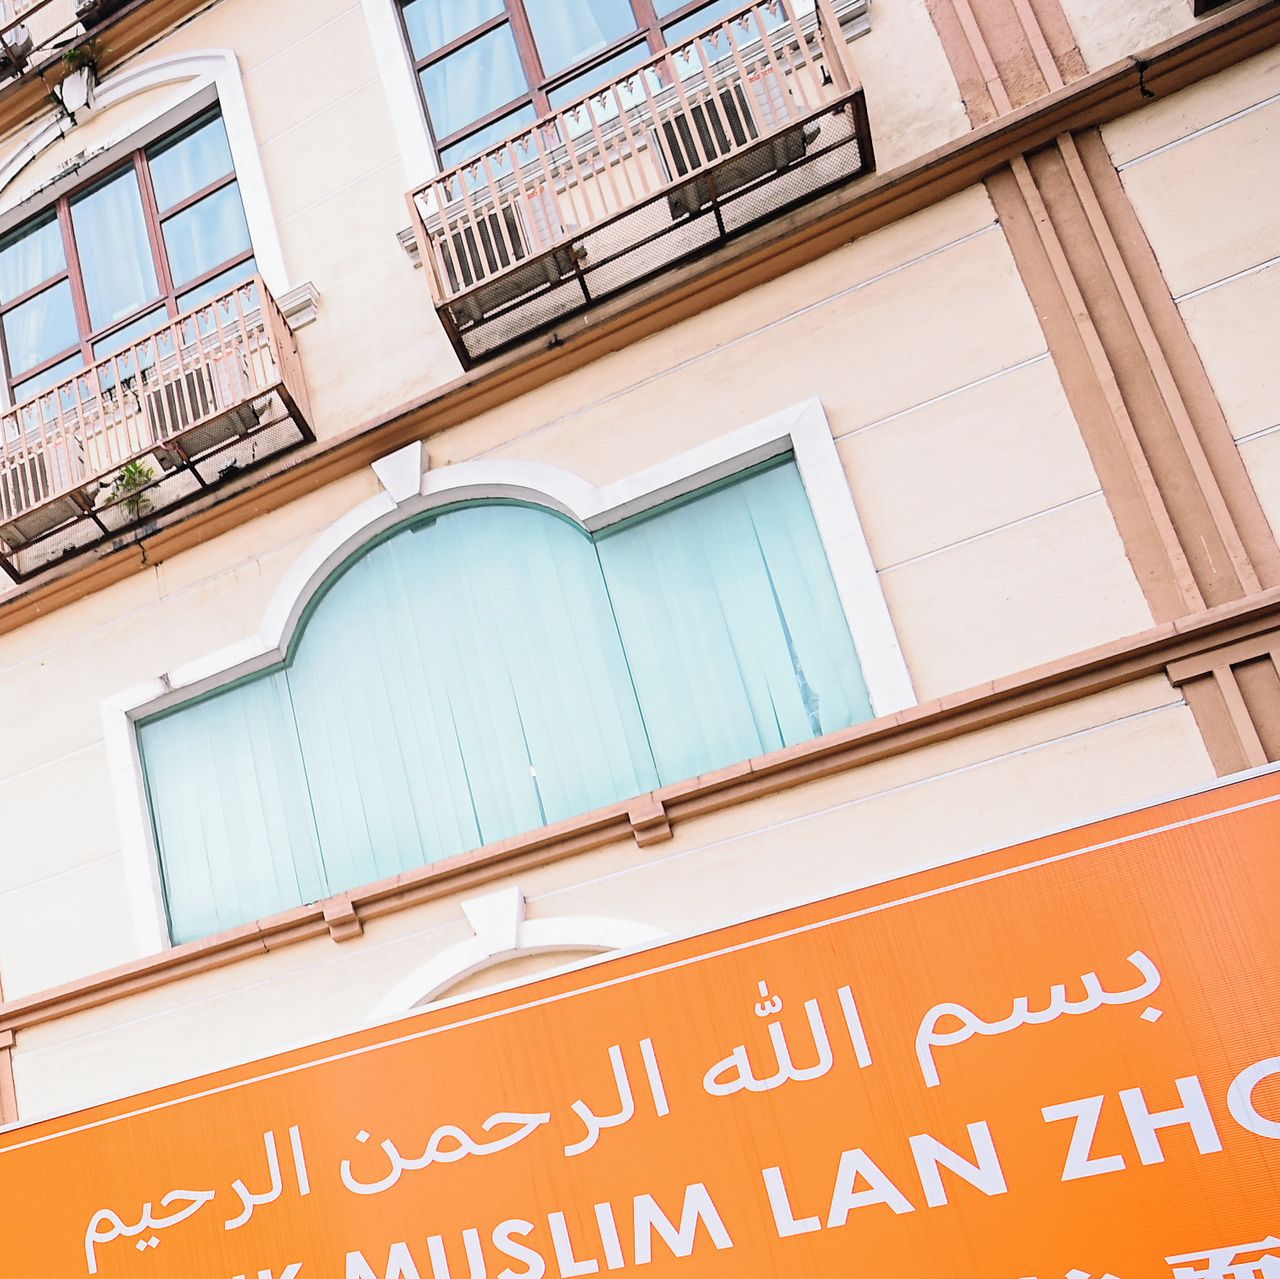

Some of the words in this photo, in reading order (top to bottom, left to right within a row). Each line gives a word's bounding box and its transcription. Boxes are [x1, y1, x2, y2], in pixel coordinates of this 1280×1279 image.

[914, 950, 1163, 1088] بسم
[340, 1036, 671, 1196] الرحمن
[761, 1119, 1009, 1238] LAN
[83, 1124, 312, 1275] الرحيم
